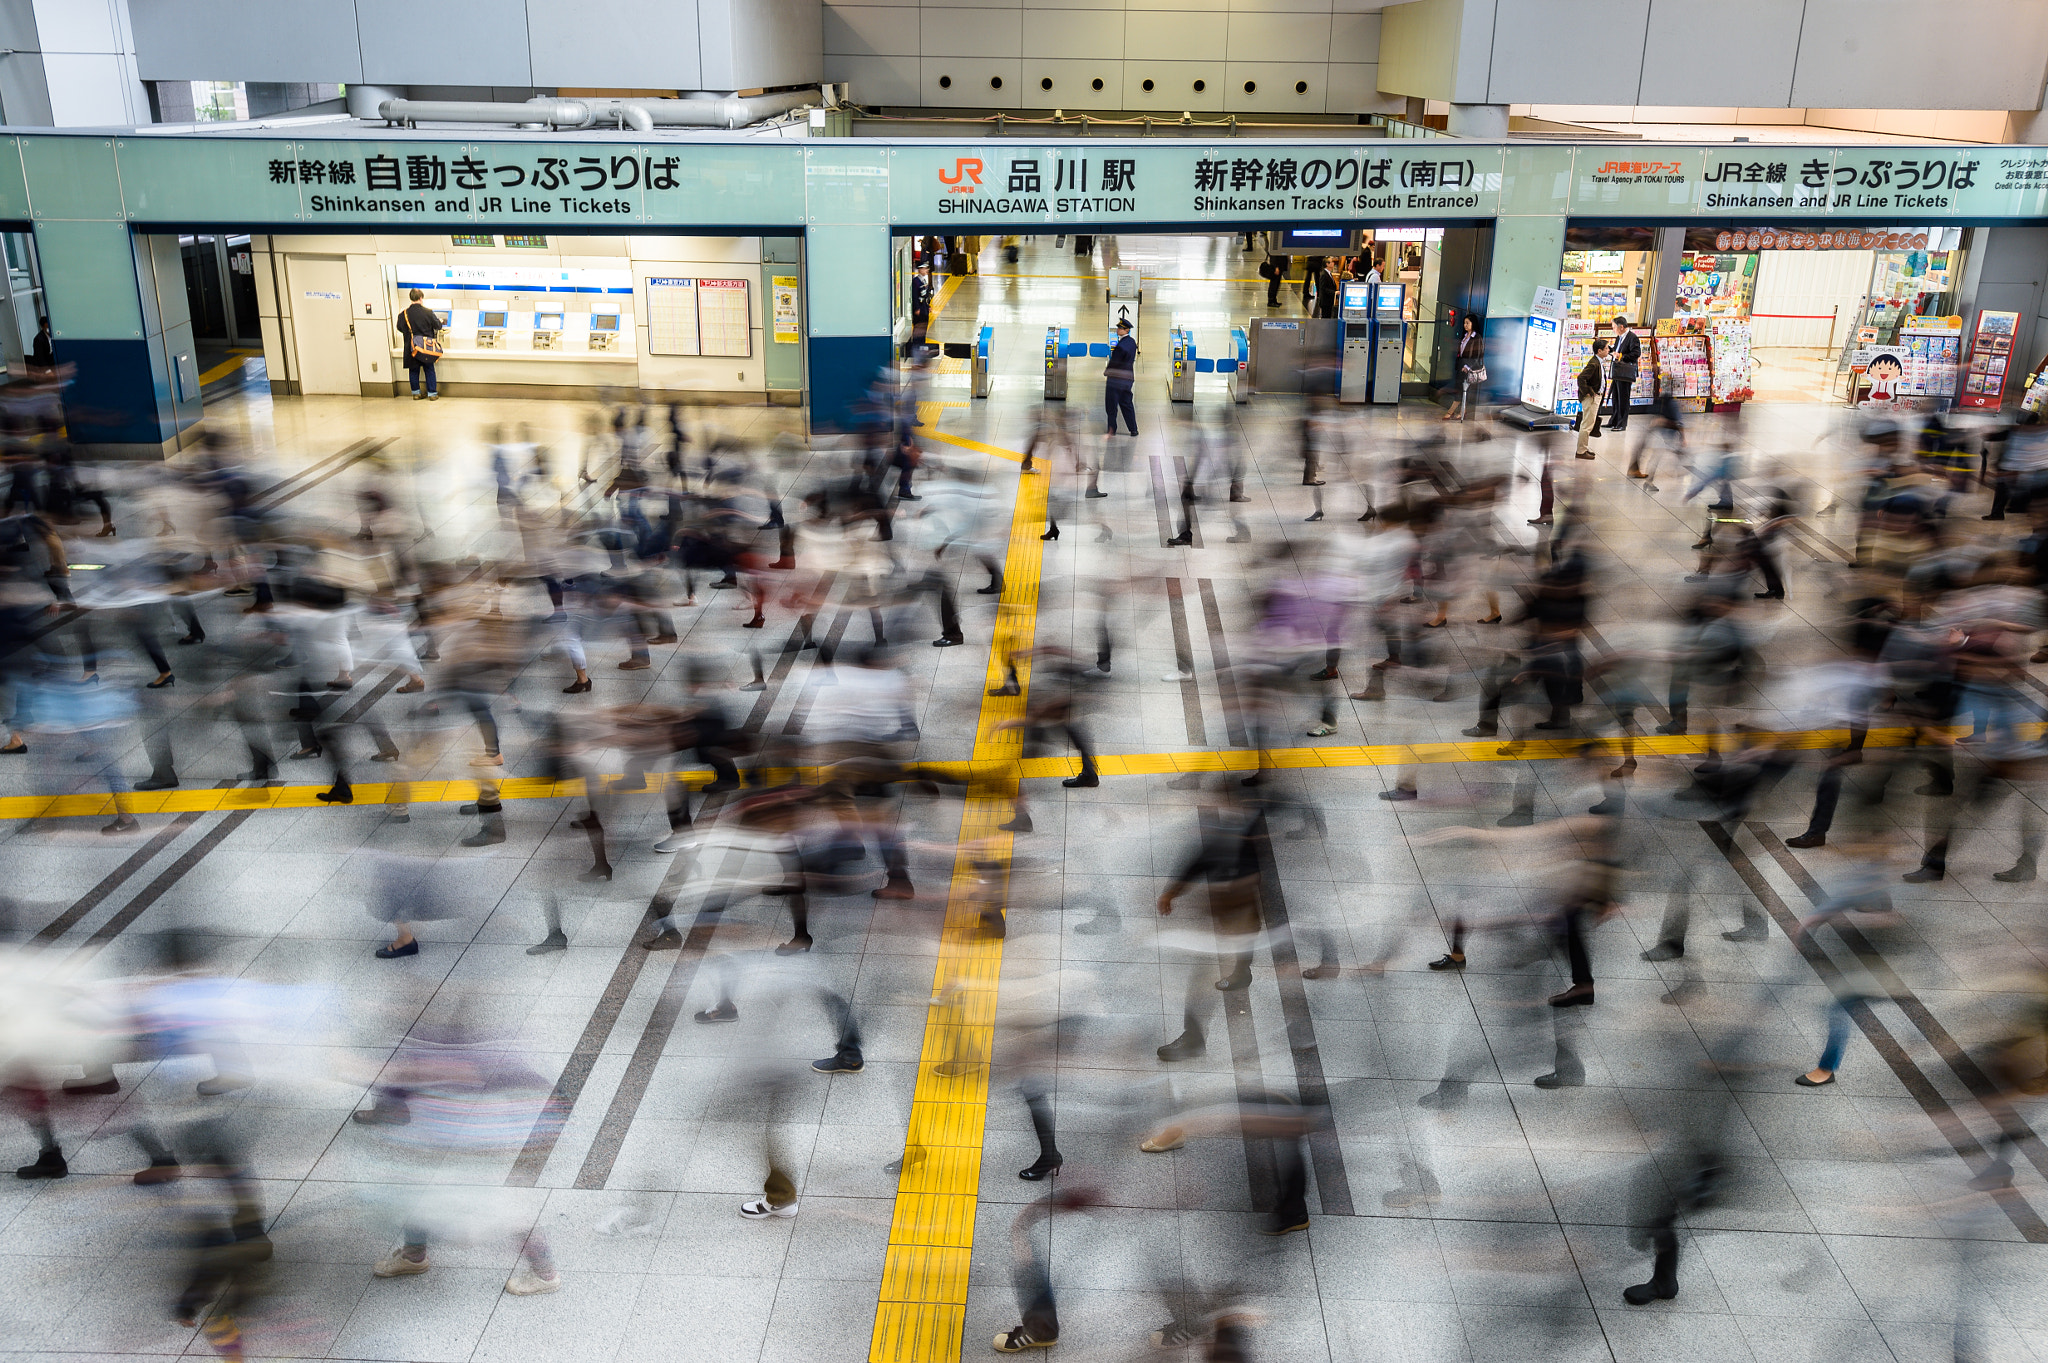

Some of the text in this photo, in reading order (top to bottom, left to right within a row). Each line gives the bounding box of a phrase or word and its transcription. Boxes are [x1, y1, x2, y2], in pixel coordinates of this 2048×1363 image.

[269, 154, 680, 191] 新幹線 自動きっぷうりば
[939, 158, 983, 184] JR
[1008, 158, 1136, 193] 品川駅
[1598, 161, 1682, 174] JR東海ツアーズ
[1704, 158, 1981, 190] JR全線 きっぷうりば
[1592, 175, 1685, 184] Travel Agency JR TOKAI TOURS
[1995, 182, 2013, 190] Credit
[2014, 181, 2031, 190] Cards
[947, 186, 975, 194] JR東海
[311, 195, 631, 213] Shinkansen and JR Line Tickets
[938, 197, 1135, 214] SHINAGAWA STATION
[1194, 194, 1479, 211] Shinkansen Tracks (South Entrance)
[1706, 193, 1948, 208] Shinkansen and JR Line Tickets
